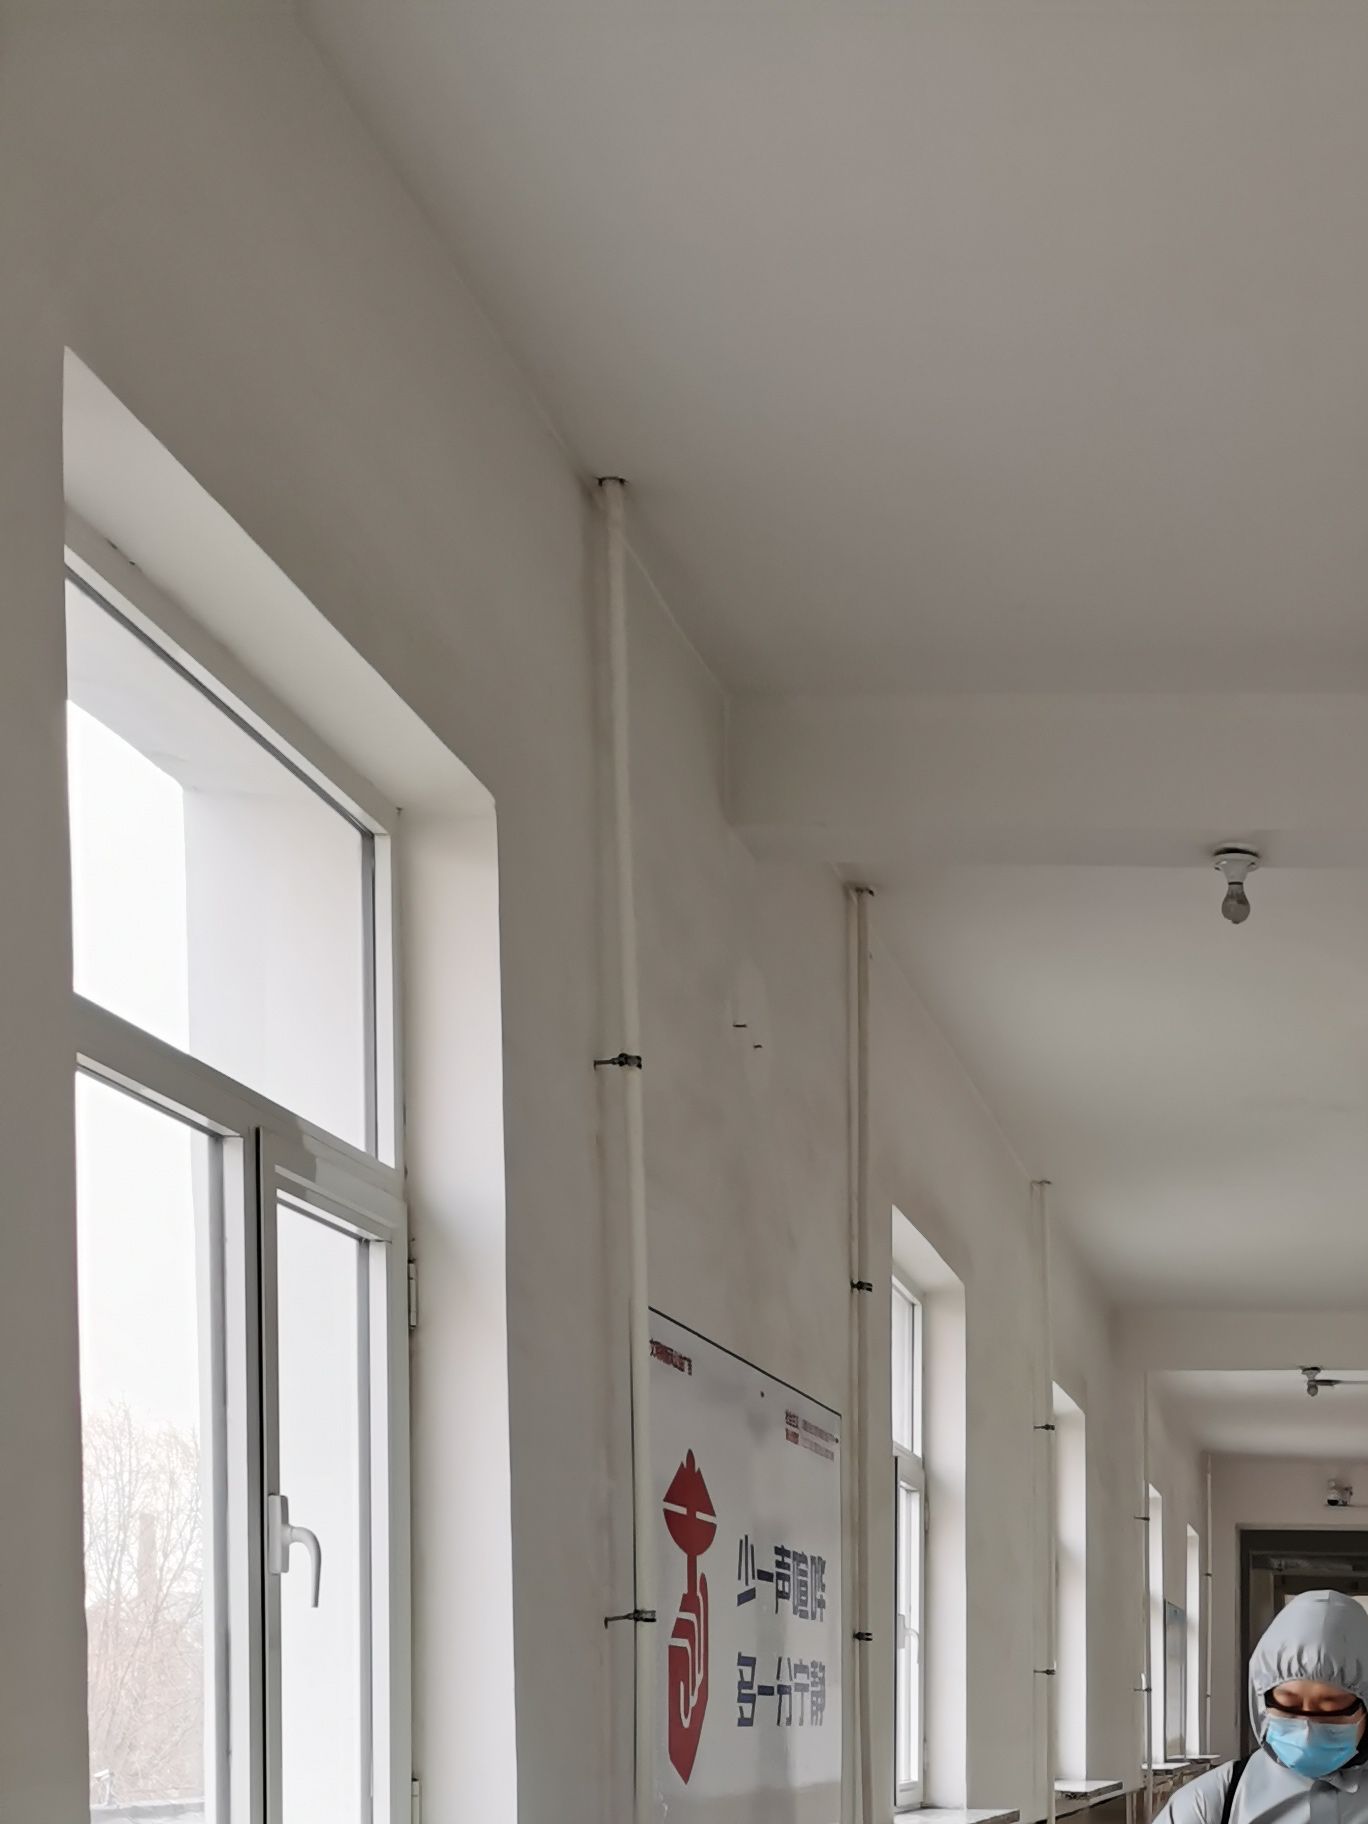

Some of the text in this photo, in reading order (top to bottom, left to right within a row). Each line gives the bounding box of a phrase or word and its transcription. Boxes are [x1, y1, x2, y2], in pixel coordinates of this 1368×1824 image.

[737, 1534, 826, 1622] 少一声喧哗
[737, 1652, 826, 1727] 多一分宁静
